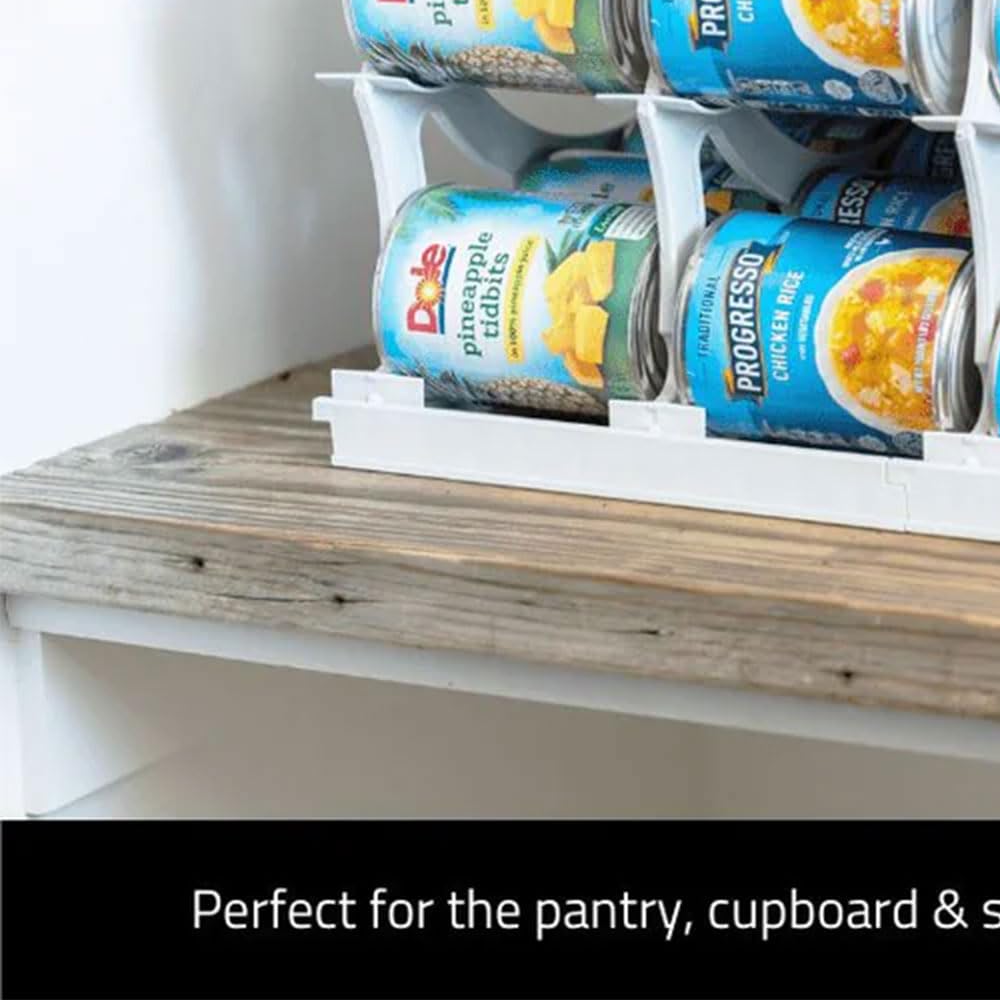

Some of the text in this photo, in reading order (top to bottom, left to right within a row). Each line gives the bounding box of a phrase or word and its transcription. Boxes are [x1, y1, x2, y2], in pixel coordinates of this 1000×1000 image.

[406, 243, 447, 335] Dole
[457, 232, 493, 357] pineapple
[483, 253, 509, 339] tidbits
[698, 276, 721, 358] TRADITIONAL
[729, 251, 765, 393] PROGRESSO
[772, 270, 804, 382] CHICKEN RICE
